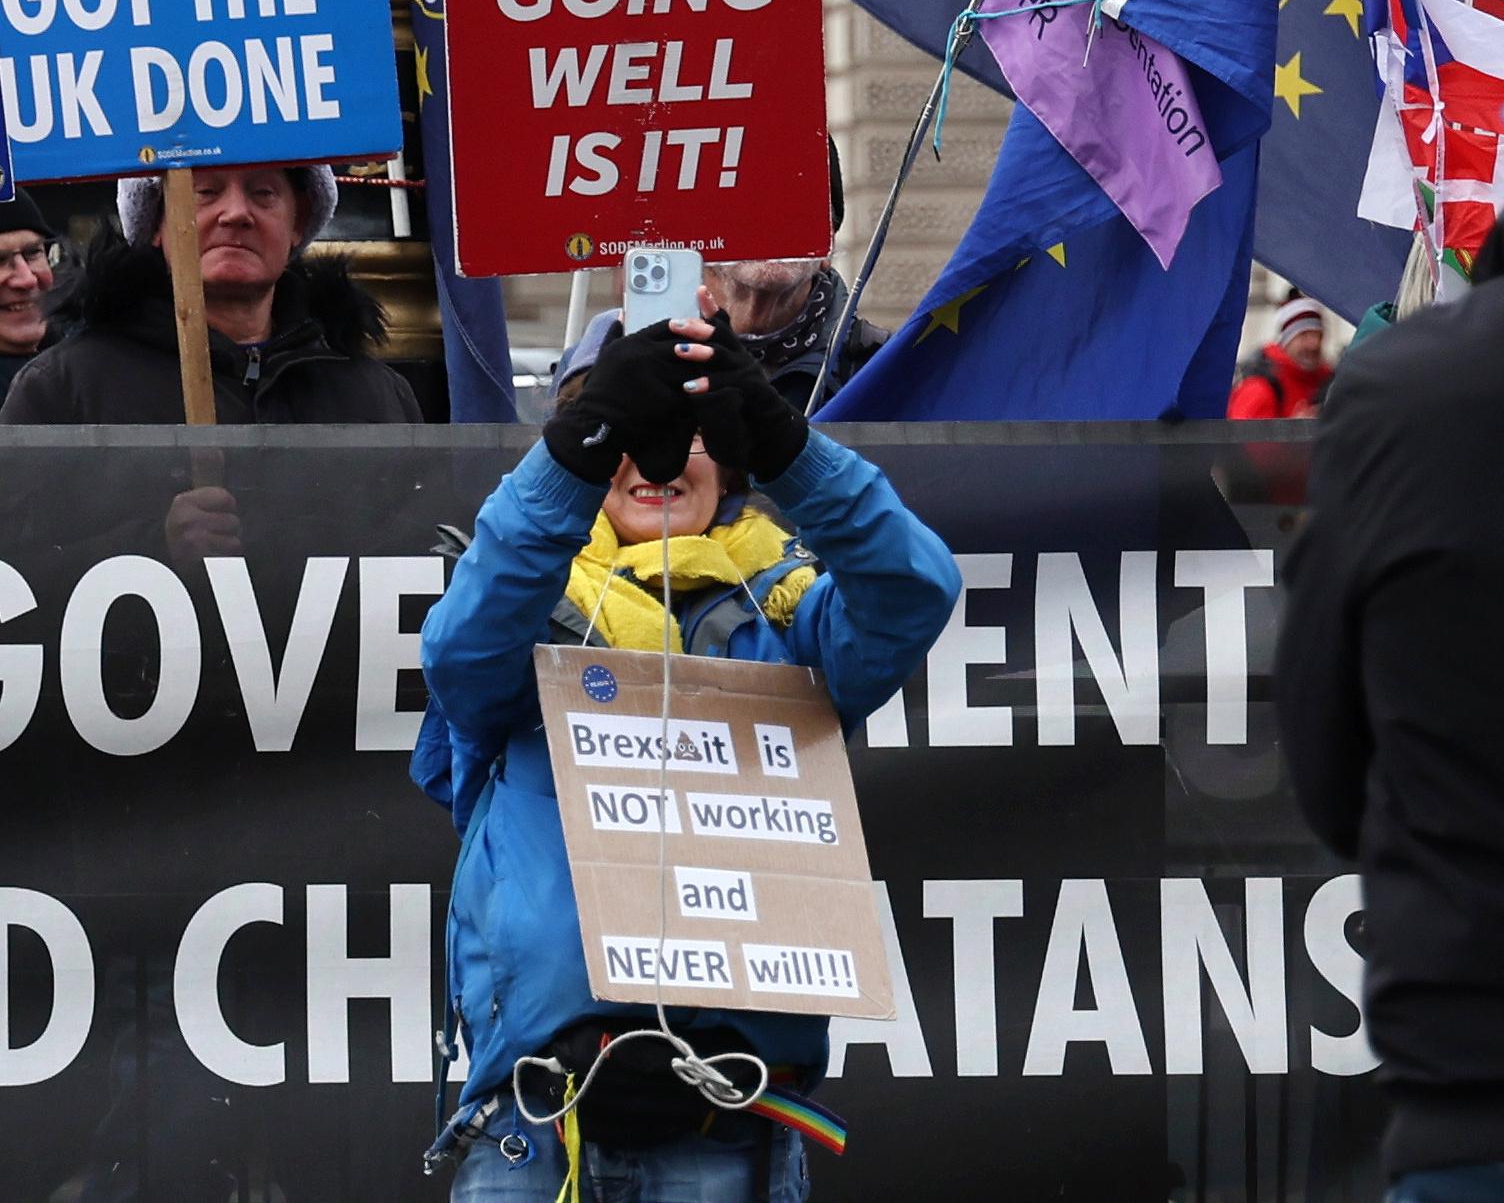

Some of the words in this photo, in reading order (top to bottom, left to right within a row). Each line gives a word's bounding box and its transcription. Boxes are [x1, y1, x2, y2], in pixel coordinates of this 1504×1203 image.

[0, 50, 113, 143] UK
[130, 33, 341, 133] DONE
[528, 38, 753, 109] WELL
[545, 132, 622, 197] IS
[637, 126, 745, 192] IT!
[764, 735, 792, 769] is
[591, 791, 668, 825] NOT
[692, 797, 837, 844] working
[681, 878, 748, 912] and
[606, 945, 730, 984] NEVER
[749, 951, 853, 988] will!!!
